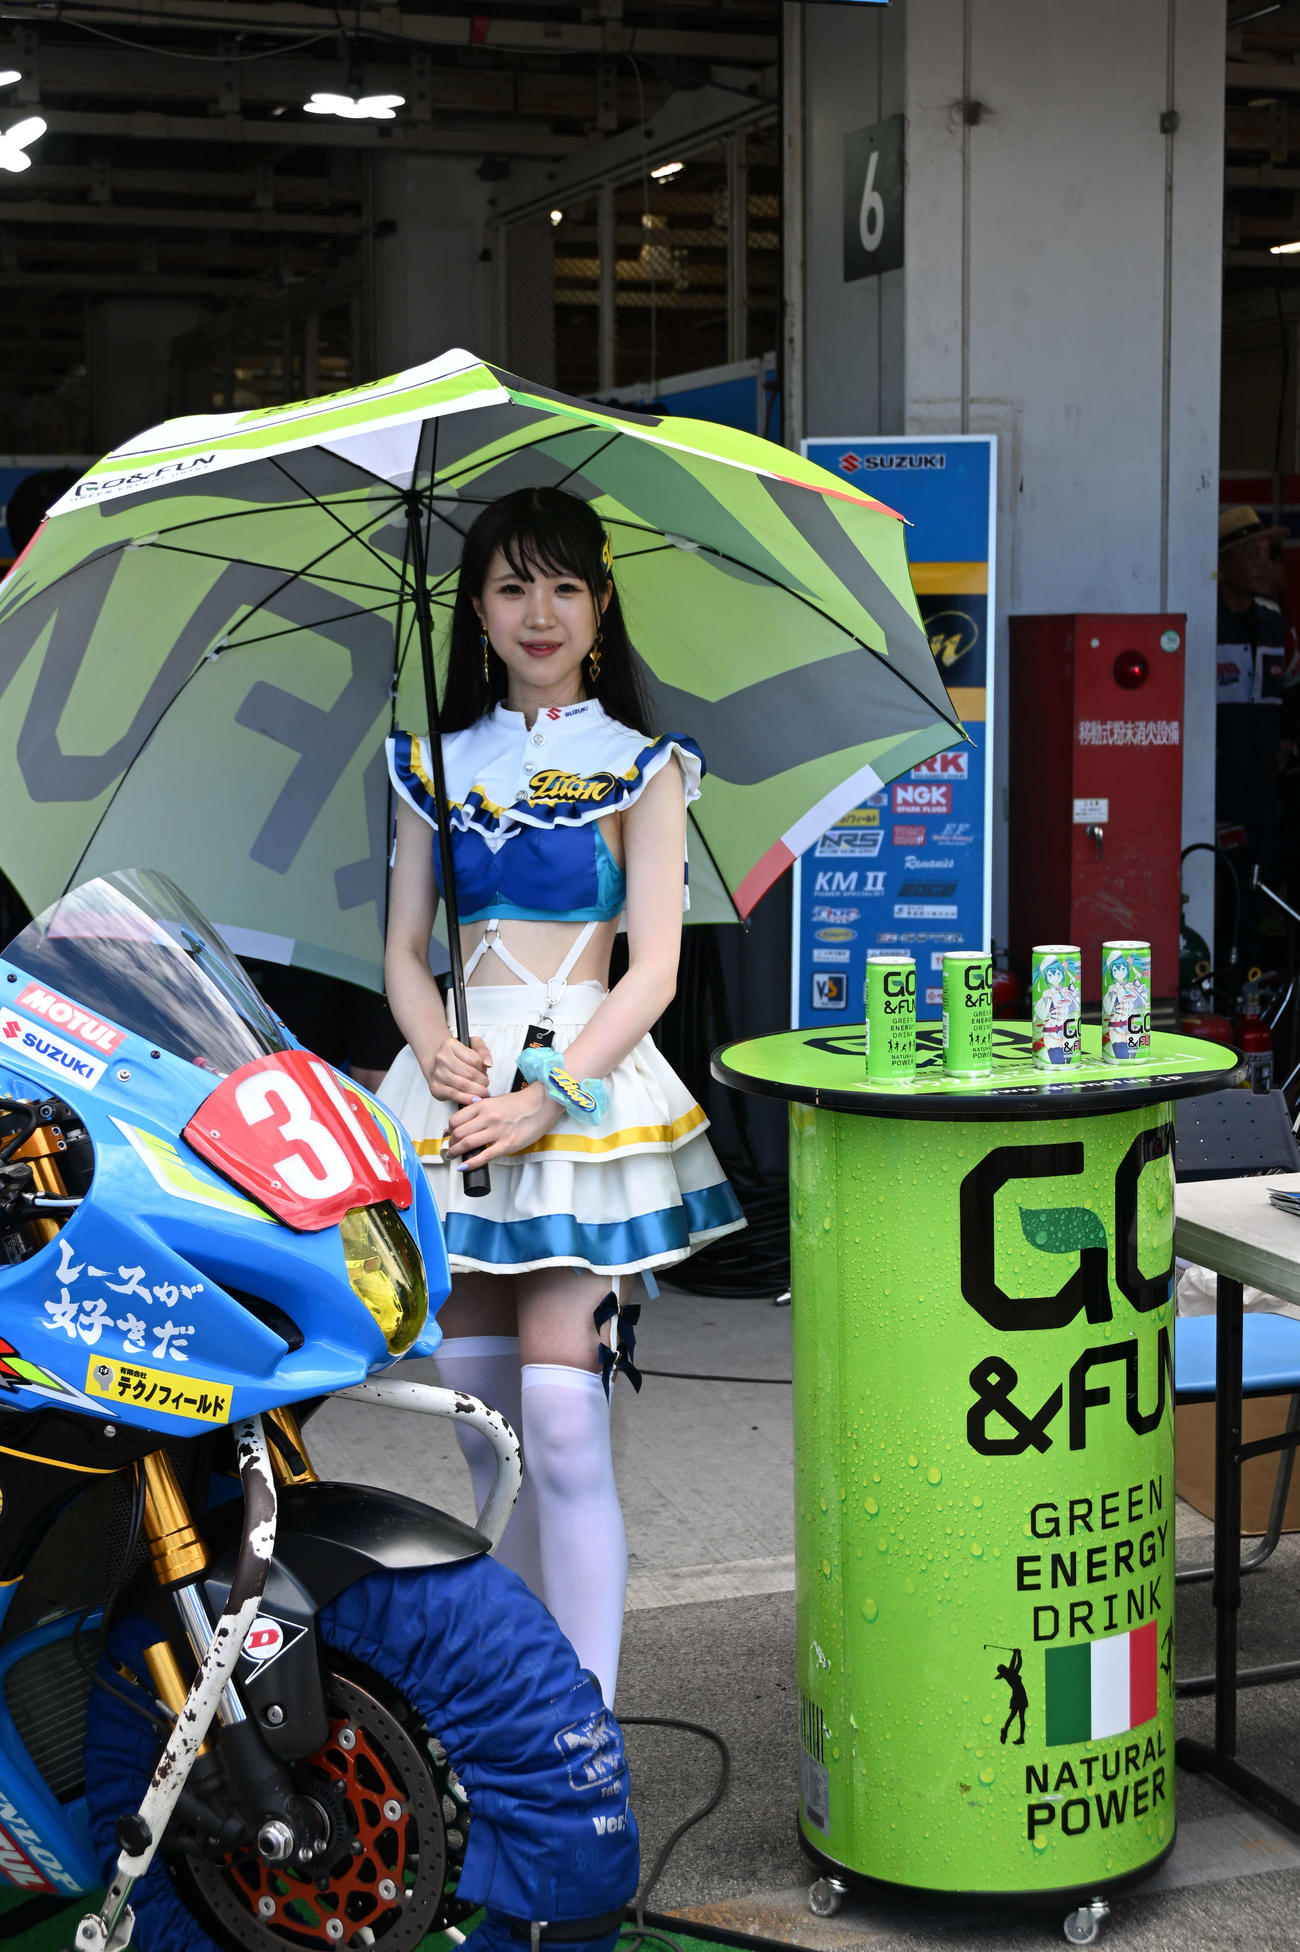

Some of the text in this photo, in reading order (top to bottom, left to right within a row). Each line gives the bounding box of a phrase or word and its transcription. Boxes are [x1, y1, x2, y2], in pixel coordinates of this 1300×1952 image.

[859, 151, 885, 252] 6
[864, 454, 946, 470] SUZUKI
[564, 705, 589, 719] SUZUKI
[896, 785, 948, 804] NGK
[814, 871, 859, 891] KM
[21, 988, 118, 1051] MOTUL
[22, 1031, 96, 1080] SUZUKI
[235, 1061, 392, 1200] 31
[960, 1121, 1174, 1331] GO
[55, 1238, 204, 1308] レースが
[33, 1287, 196, 1362] 好きだ
[118, 1376, 226, 1417] テクノフィールド
[120, 1366, 148, 1380] 有限会社
[1030, 1474, 1163, 1539] GREEN
[1016, 1520, 1169, 1591] ENERGY
[248, 1628, 280, 1650] D
[1033, 1575, 1162, 1641] DRINK
[1025, 1729, 1166, 1794] NATURAL
[1027, 1766, 1166, 1841] POWER
